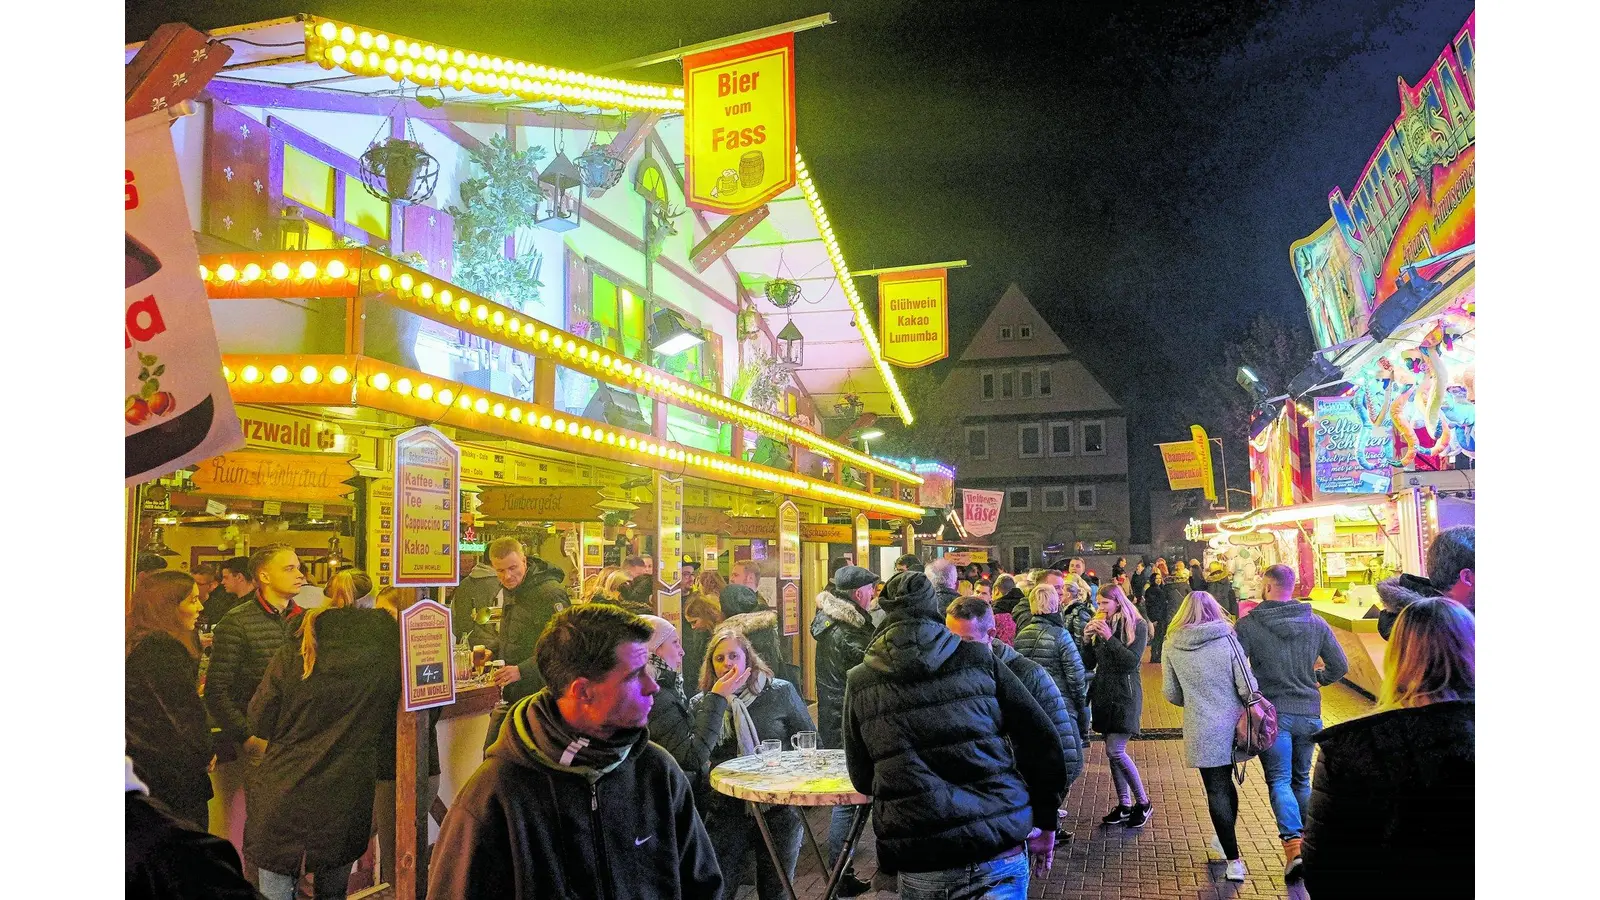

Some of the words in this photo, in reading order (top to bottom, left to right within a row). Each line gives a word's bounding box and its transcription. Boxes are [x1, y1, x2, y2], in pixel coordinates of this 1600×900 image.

[717, 69, 760, 97] Bier
[725, 100, 752, 116] vom
[712, 123, 766, 152] Fass
[890, 296, 937, 312] Glühwein
[897, 315, 930, 327] Kakao
[889, 330, 938, 344] Lumumba
[240, 418, 311, 448] rzwald
[1316, 417, 1362, 438] Selfie
[405, 472, 433, 488] Kaffee
[405, 492, 422, 508] Tee
[965, 504, 998, 522] Käse
[405, 513, 440, 533] Cappuccino
[404, 539, 430, 555] Kakao
[413, 687, 426, 698] ZUM
[427, 685, 448, 696] WOHLE!
